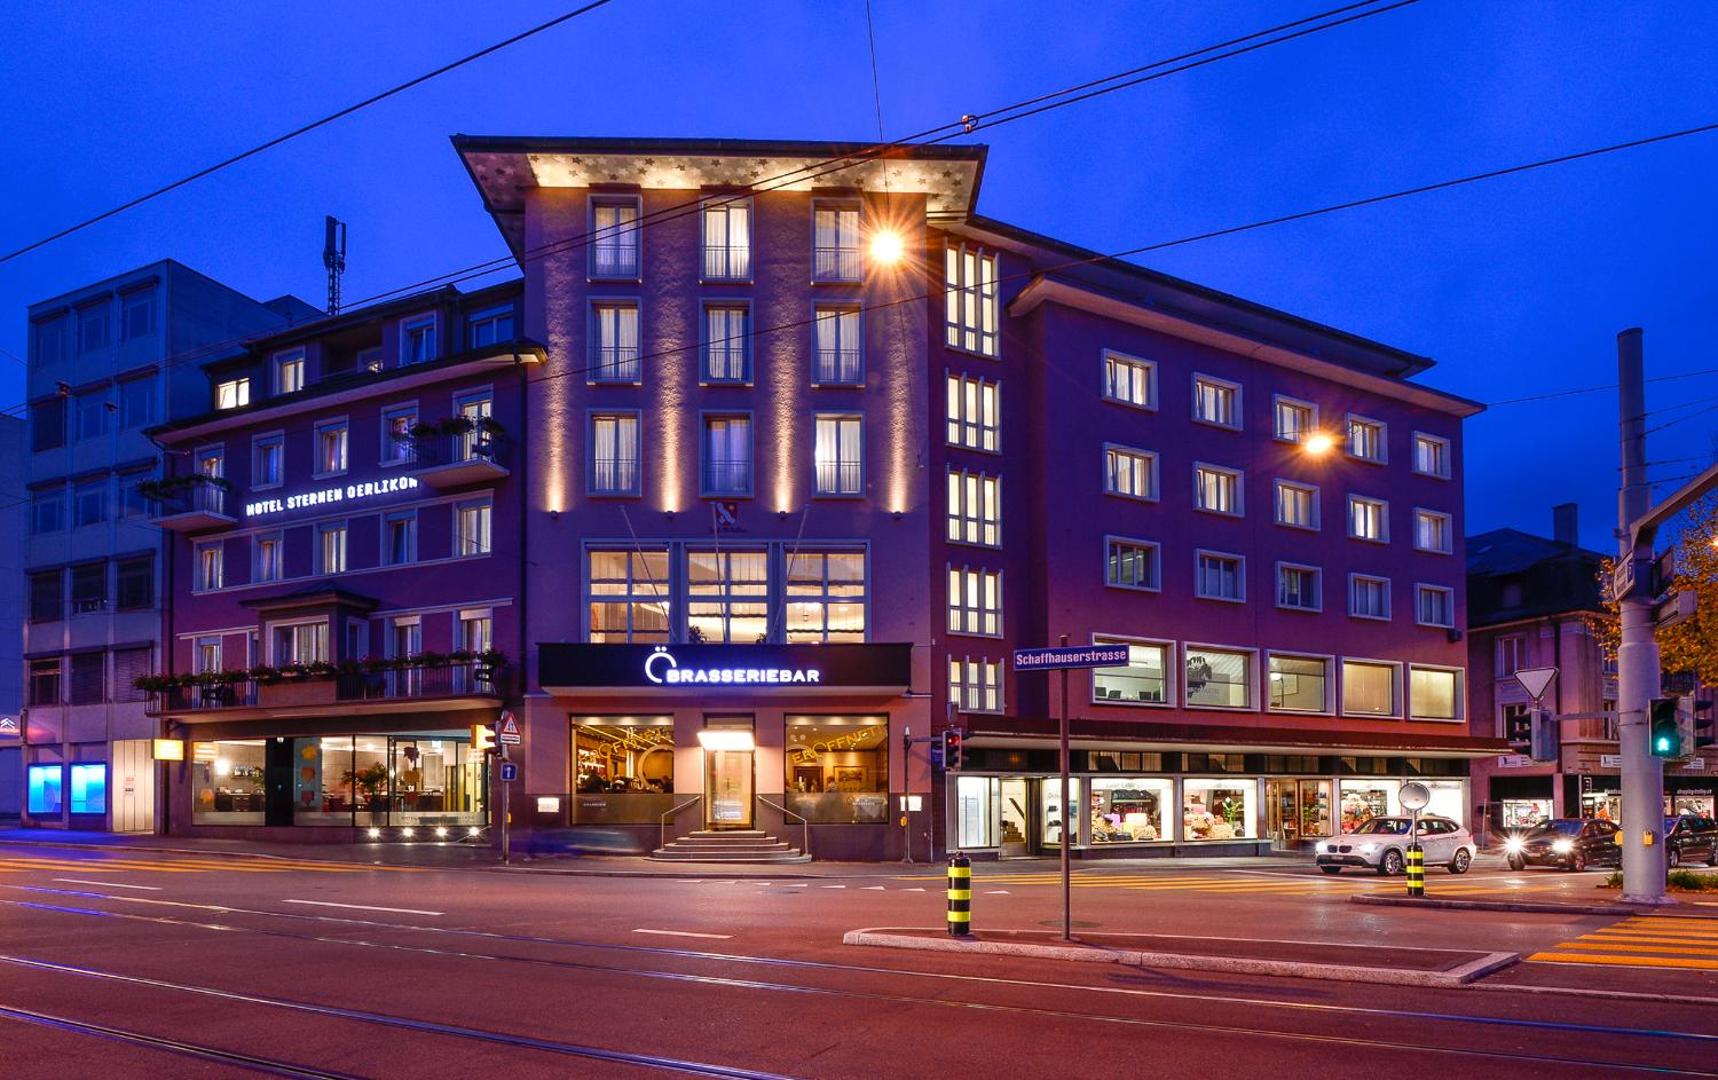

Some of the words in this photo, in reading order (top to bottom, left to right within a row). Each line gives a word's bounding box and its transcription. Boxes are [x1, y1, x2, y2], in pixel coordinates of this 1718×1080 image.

[246, 499, 284, 517] HOTEL
[287, 488, 343, 509] STERNEN
[347, 476, 418, 499] OERLIKON
[1016, 651, 1127, 665] Schaffhauserstrasse
[666, 669, 820, 683] BRASSERIEBAR
